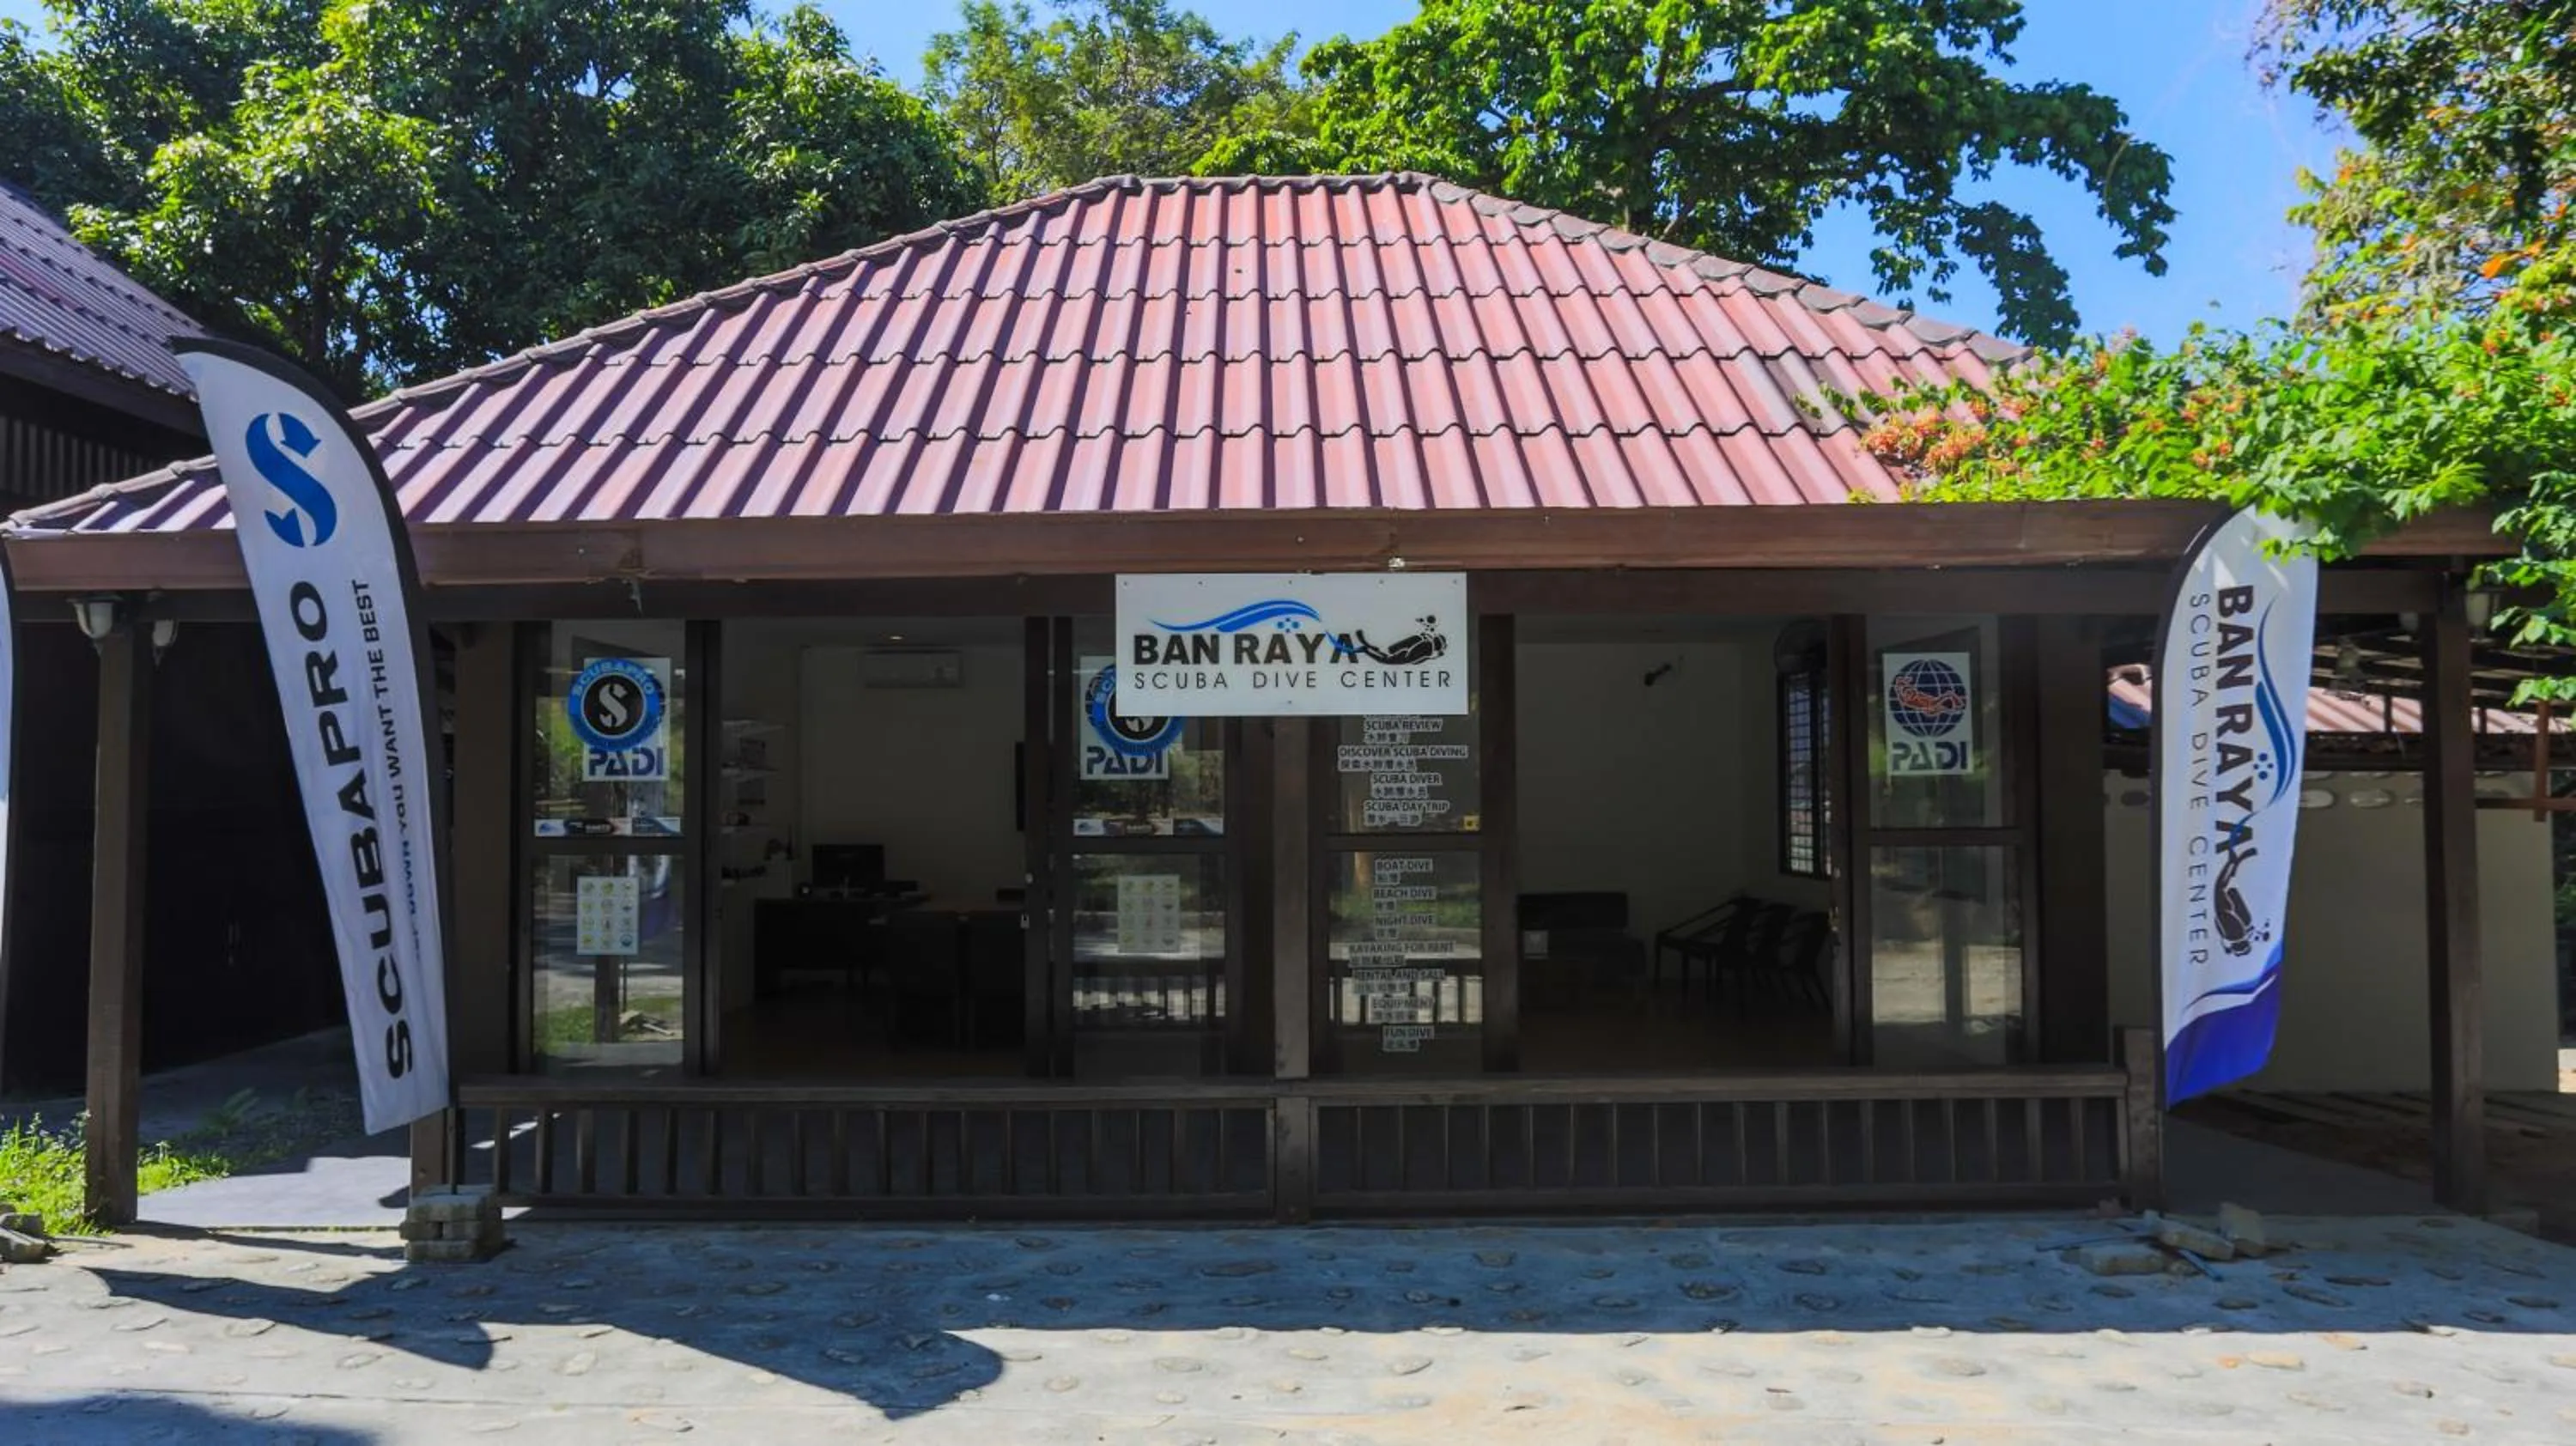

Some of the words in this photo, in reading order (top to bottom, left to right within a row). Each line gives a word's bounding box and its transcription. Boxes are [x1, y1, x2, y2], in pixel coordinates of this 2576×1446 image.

[351, 579, 380, 643] BEST
[1133, 633, 1220, 665] BAN
[1233, 632, 1359, 665] RAYA
[2190, 592, 2211, 708] SCUBA
[2215, 585, 2254, 690] BAN
[366, 647, 390, 699] THE
[1133, 672, 1228, 689] SCUBA
[1253, 671, 1317, 689] DIVE
[1340, 671, 1451, 688] CENTER
[1365, 720, 1400, 730] SCUBA
[1402, 720, 1442, 730] REVIEW
[377, 705, 402, 779] WANT
[1339, 747, 1391, 756] DISCOVER
[1393, 747, 1427, 756] SCUBA
[1429, 747, 1467, 756] DIVING
[1892, 741, 1968, 770] PADI
[588, 747, 664, 776] PADI
[1086, 745, 1163, 775] PADI
[2190, 732, 2209, 811] DIVE
[1373, 774, 1406, 784] SCUBA
[1409, 774, 1440, 784] DIVER
[2215, 703, 2255, 854] RAYA
[390, 783, 408, 835] YOU
[1365, 801, 1400, 811] SCUBA
[1402, 801, 1423, 811] DAY
[1425, 801, 1449, 811] TRIP
[289, 580, 414, 1079] SCUBAPRO
[1376, 860, 1406, 871] BOAT
[1407, 860, 1430, 871] DIVE
[1374, 888, 1407, 898] BEACH
[1410, 888, 1433, 898] DIVE
[2188, 835, 2208, 965] CENTER
[1376, 915, 1406, 926] NIGHT
[1410, 914, 1434, 925] DIVE
